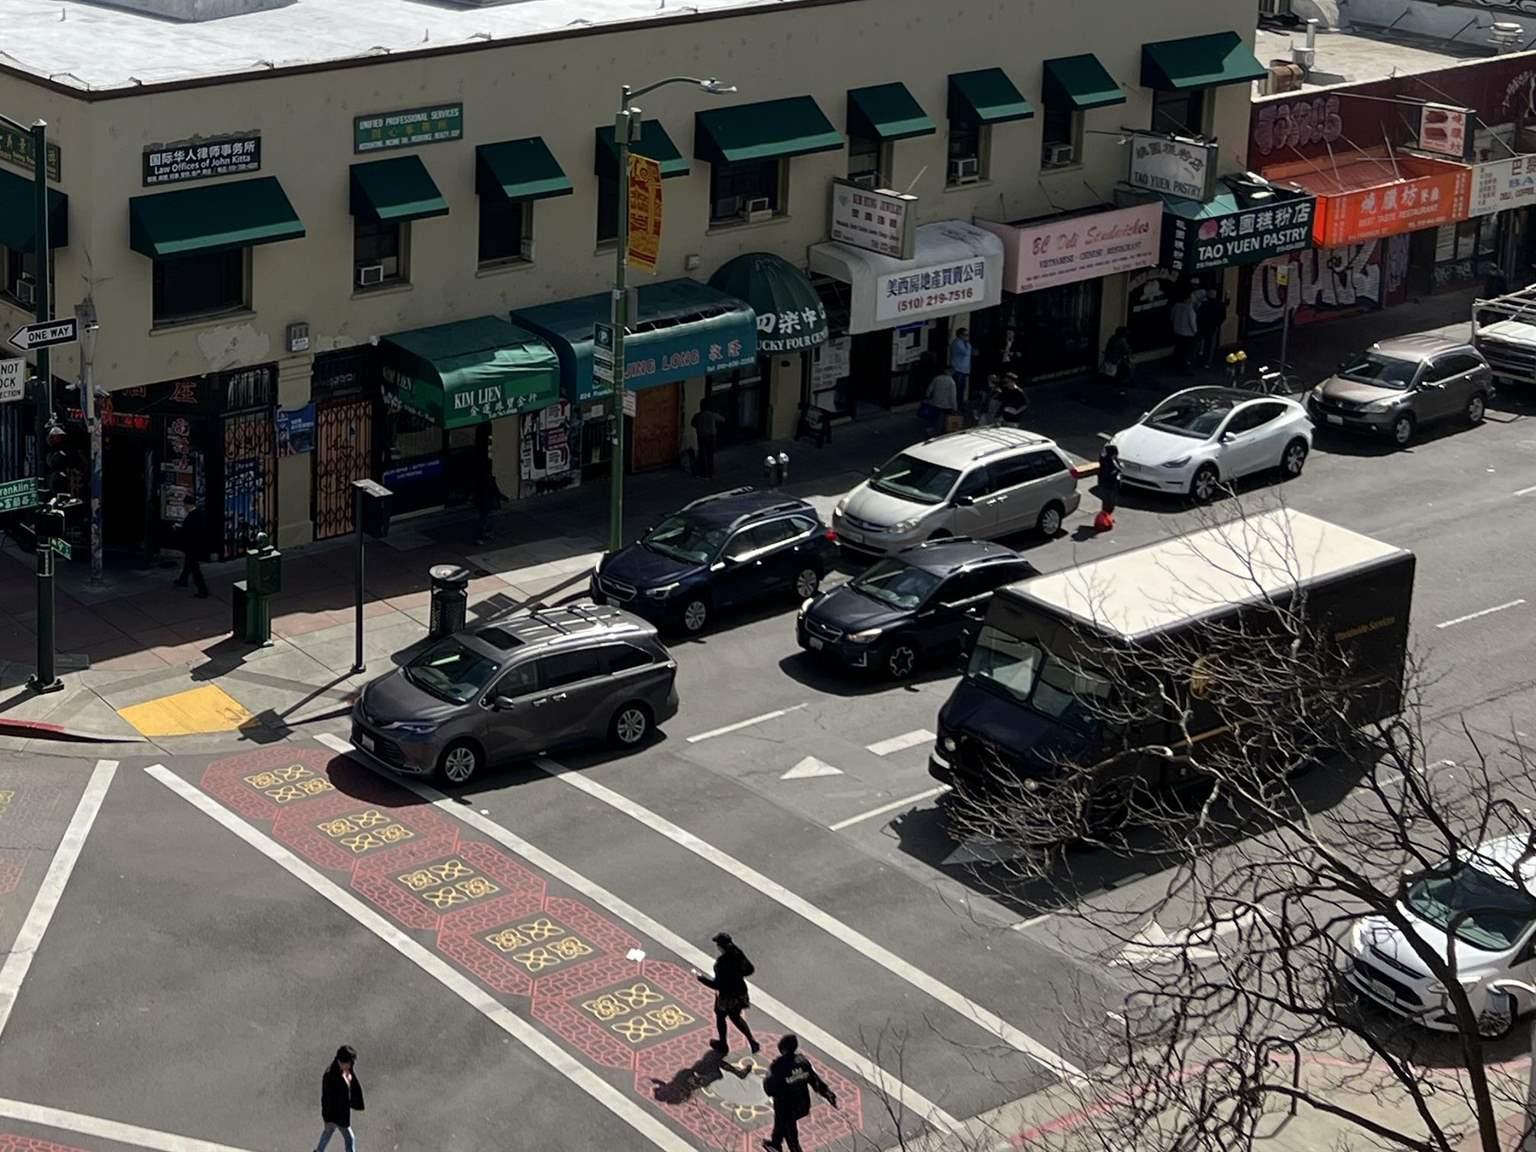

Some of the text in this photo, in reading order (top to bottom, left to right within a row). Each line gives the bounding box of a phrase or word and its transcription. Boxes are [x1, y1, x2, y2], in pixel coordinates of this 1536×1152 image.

[154, 165, 170, 175] Law
[172, 161, 199, 173] Offices
[201, 159, 209, 168] of
[211, 157, 230, 168] John
[1084, 218, 1149, 246] Sandwiches
[1198, 244, 1224, 261] TAO
[1226, 235, 1261, 255] YUEN
[1263, 226, 1309, 248] PASTRY
[897, 288, 973, 312] (510) 219-7516
[28, 326, 70, 342] ONE WAY
[758, 339, 784, 351] UCKY
[786, 335, 812, 349] FOUR
[0, 363, 19, 375] NOT
[662, 349, 700, 371] LONG
[454, 391, 474, 409] KIM
[478, 385, 501, 404] LIEN
